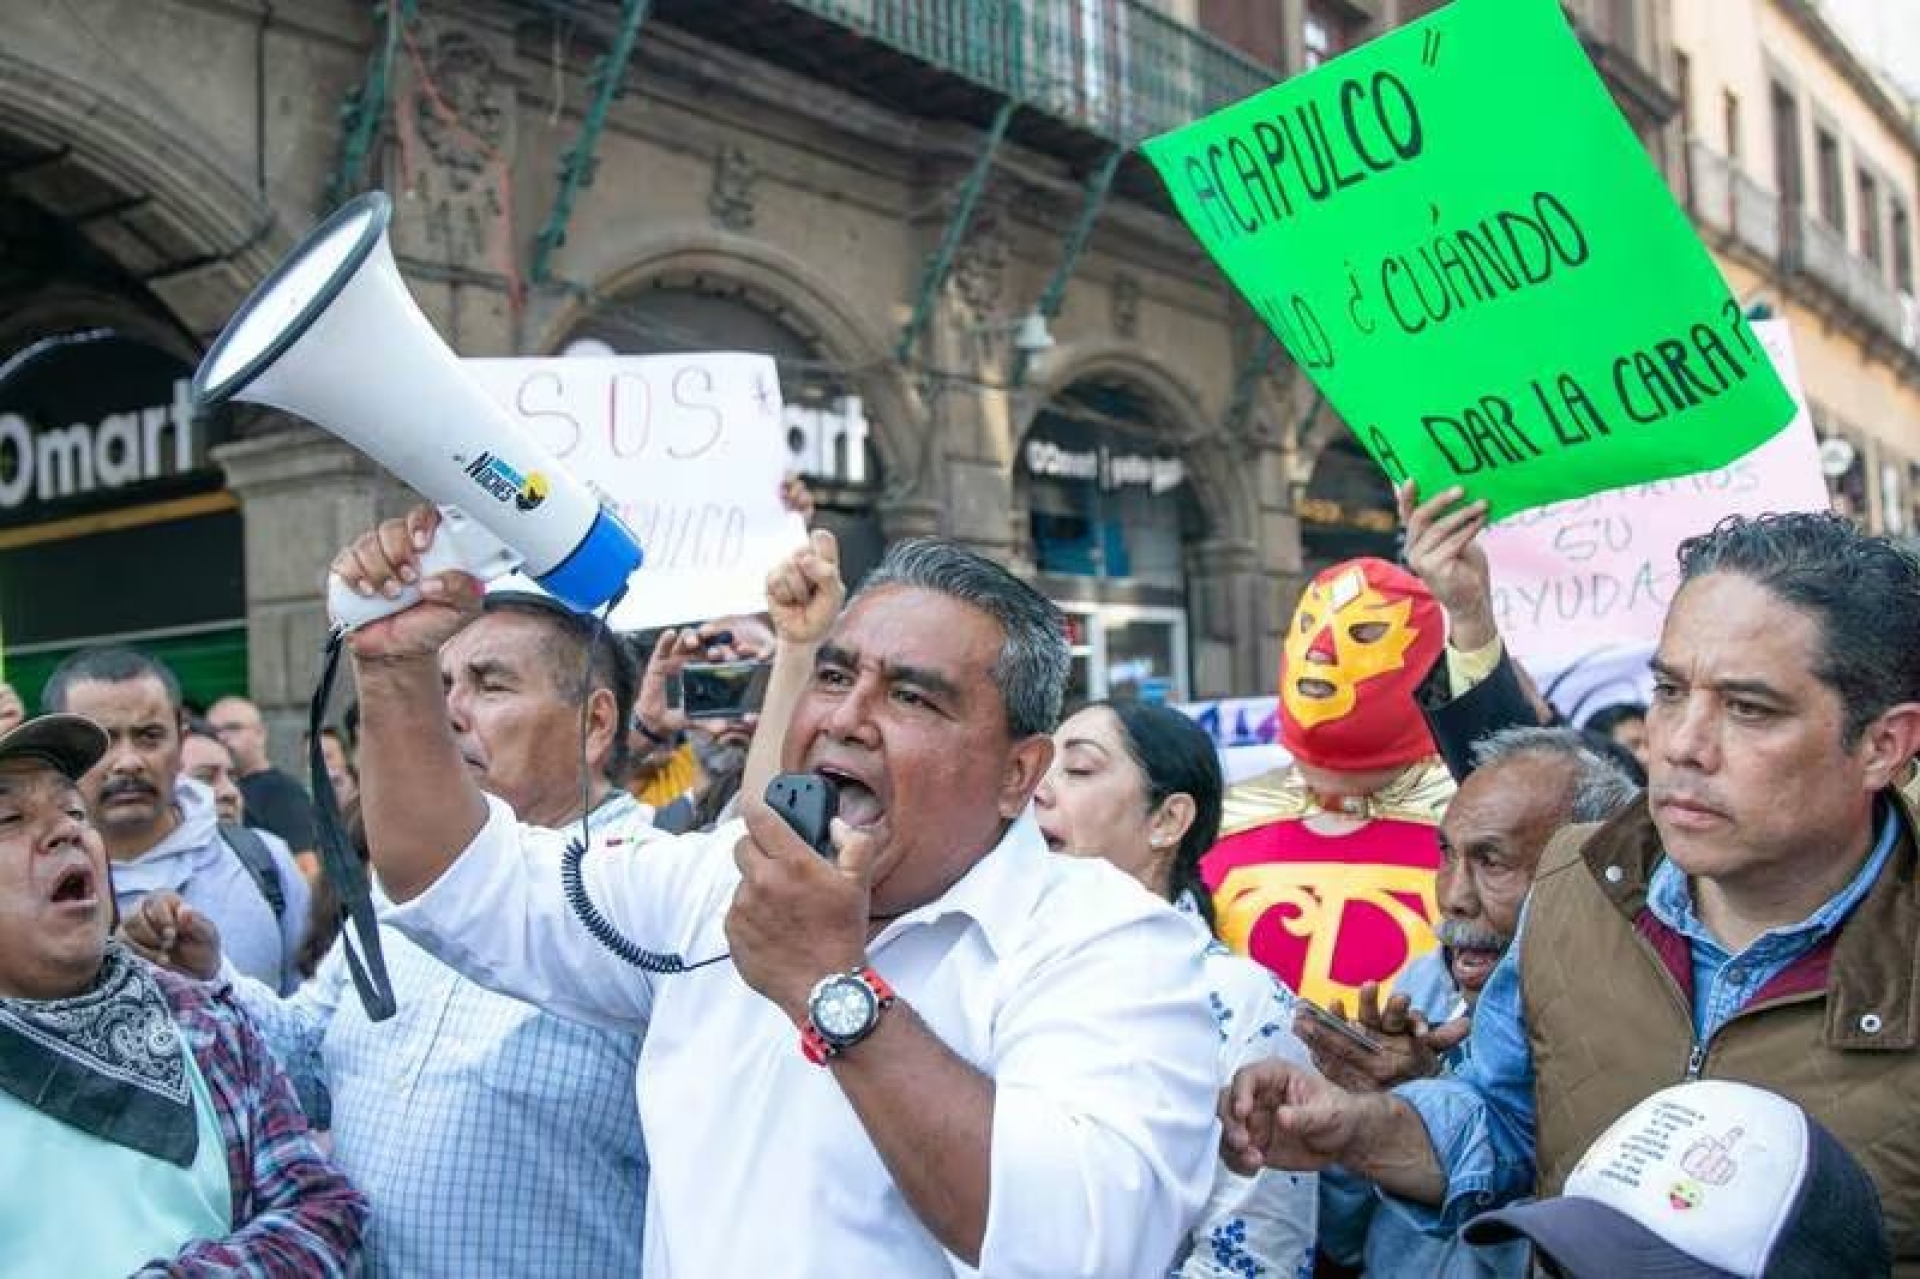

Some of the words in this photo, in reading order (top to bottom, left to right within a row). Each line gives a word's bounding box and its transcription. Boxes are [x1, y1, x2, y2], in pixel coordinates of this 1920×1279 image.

[516, 364, 724, 460] SOS
[1421, 395, 1544, 476] DAR
[1529, 373, 1612, 447] LA
[1612, 298, 1758, 425] CARA?
[1552, 510, 1633, 562] SU
